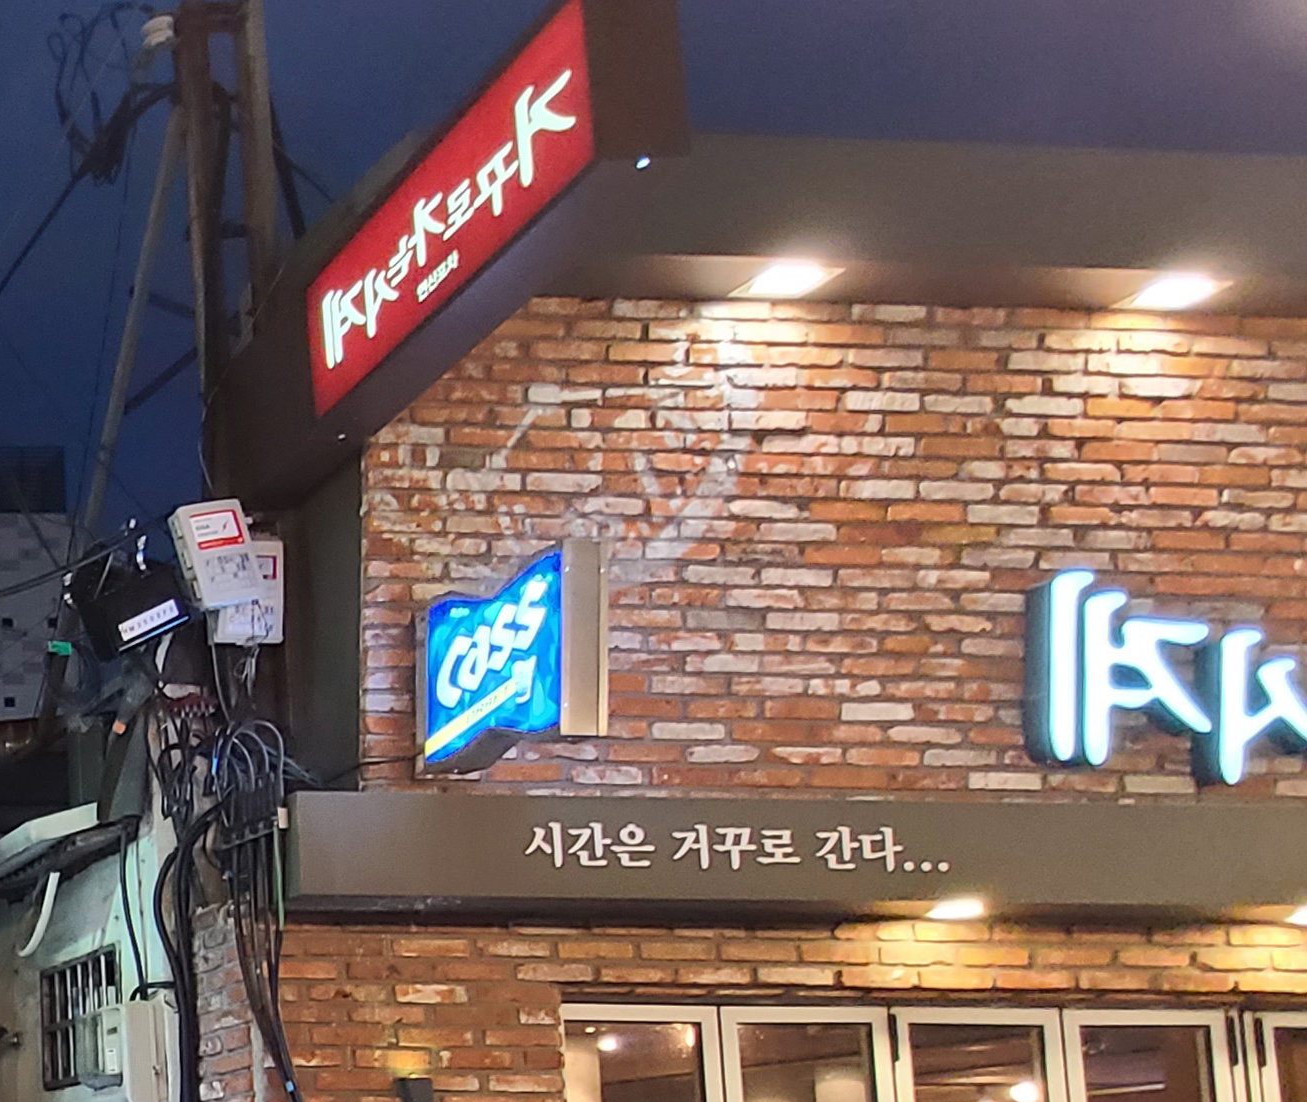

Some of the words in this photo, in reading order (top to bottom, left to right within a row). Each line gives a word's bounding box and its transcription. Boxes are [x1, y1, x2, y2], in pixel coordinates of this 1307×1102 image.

[436, 579, 548, 709] Cass
[525, 823, 653, 869] 시간은
[672, 825, 801, 869] 거꾸로
[816, 827, 951, 875] 간다...
